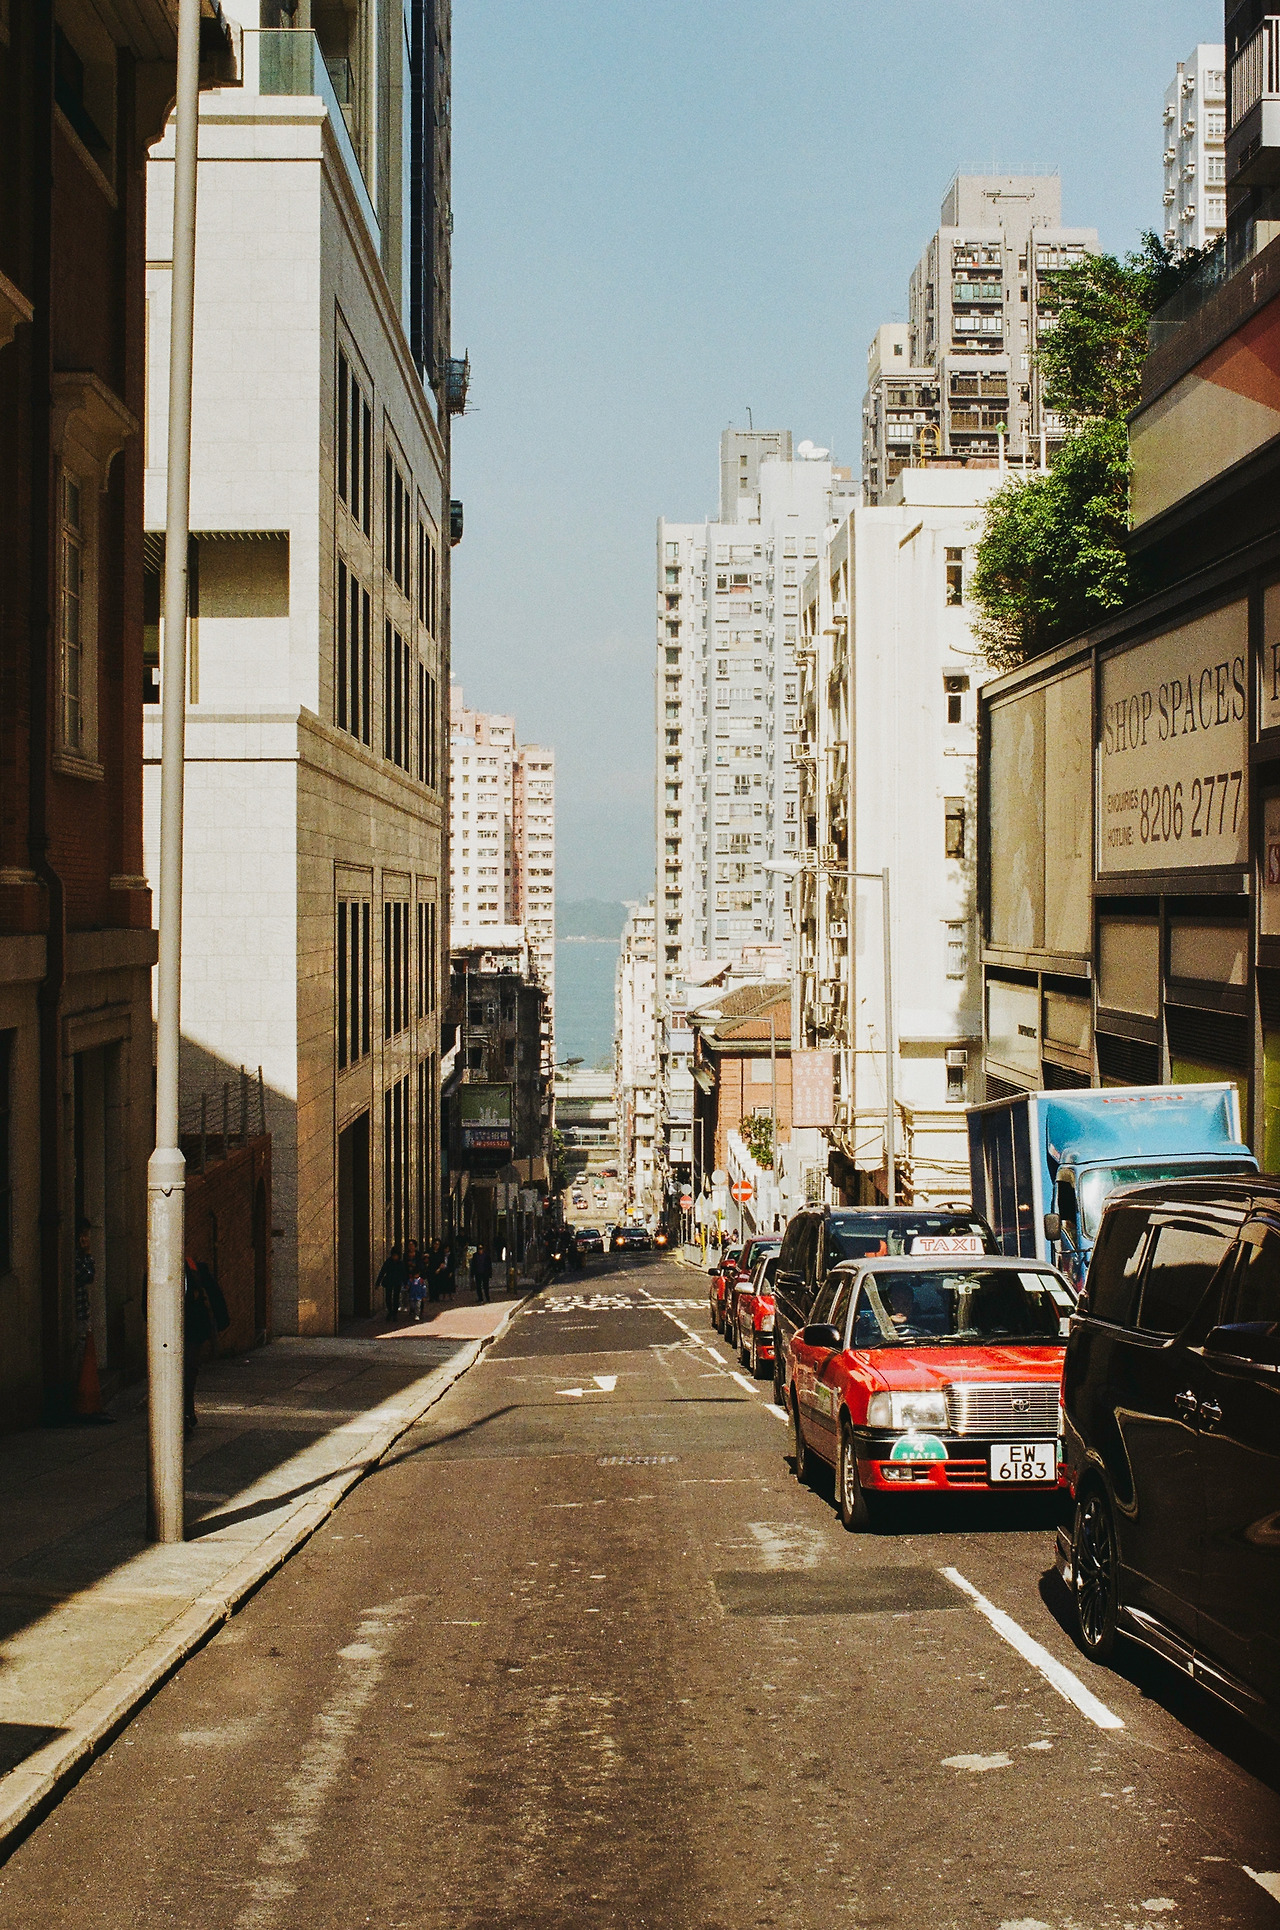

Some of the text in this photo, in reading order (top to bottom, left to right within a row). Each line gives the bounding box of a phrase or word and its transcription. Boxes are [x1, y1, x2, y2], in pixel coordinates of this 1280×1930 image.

[1105, 690, 1152, 755] SHOP
[1158, 656, 1246, 741] SPACES
[1140, 781, 1183, 844] 8206
[1191, 771, 1243, 838] 2777
[920, 1238, 976, 1251] TAXI
[913, 1441, 925, 1453] 4
[1009, 1446, 1036, 1462] EW
[1000, 1463, 1047, 1479] 6183
